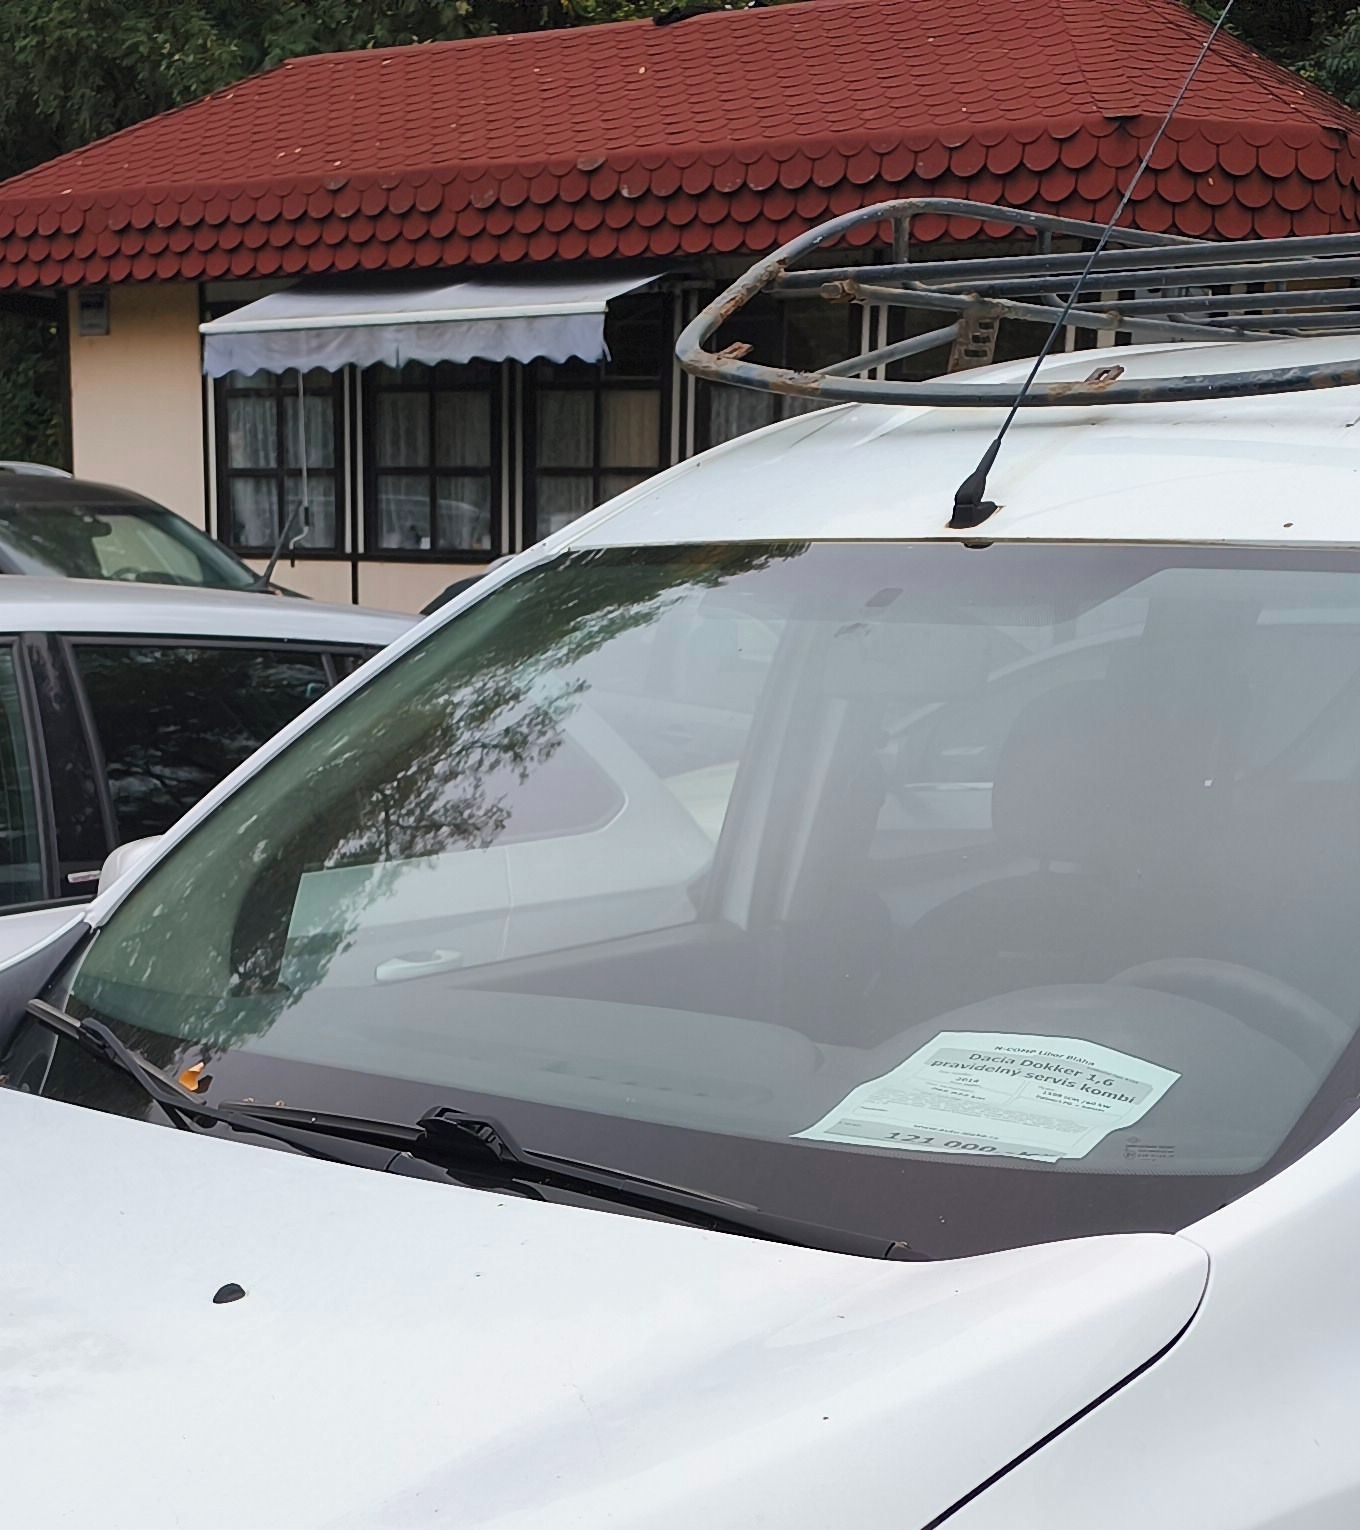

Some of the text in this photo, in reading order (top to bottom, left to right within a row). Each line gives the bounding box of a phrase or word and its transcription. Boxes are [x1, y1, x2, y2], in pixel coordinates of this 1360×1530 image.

[930, 1060, 1022, 1077] pravidelný
[1024, 1072, 1078, 1089] servis
[1080, 1083, 1137, 1104] kombi
[969, 1053, 1016, 1065] Dacia
[1020, 1059, 1083, 1077] Dokker
[1087, 1074, 1115, 1086] 1,6
[884, 1132, 935, 1145] 121
[944, 1140, 997, 1152] 000
